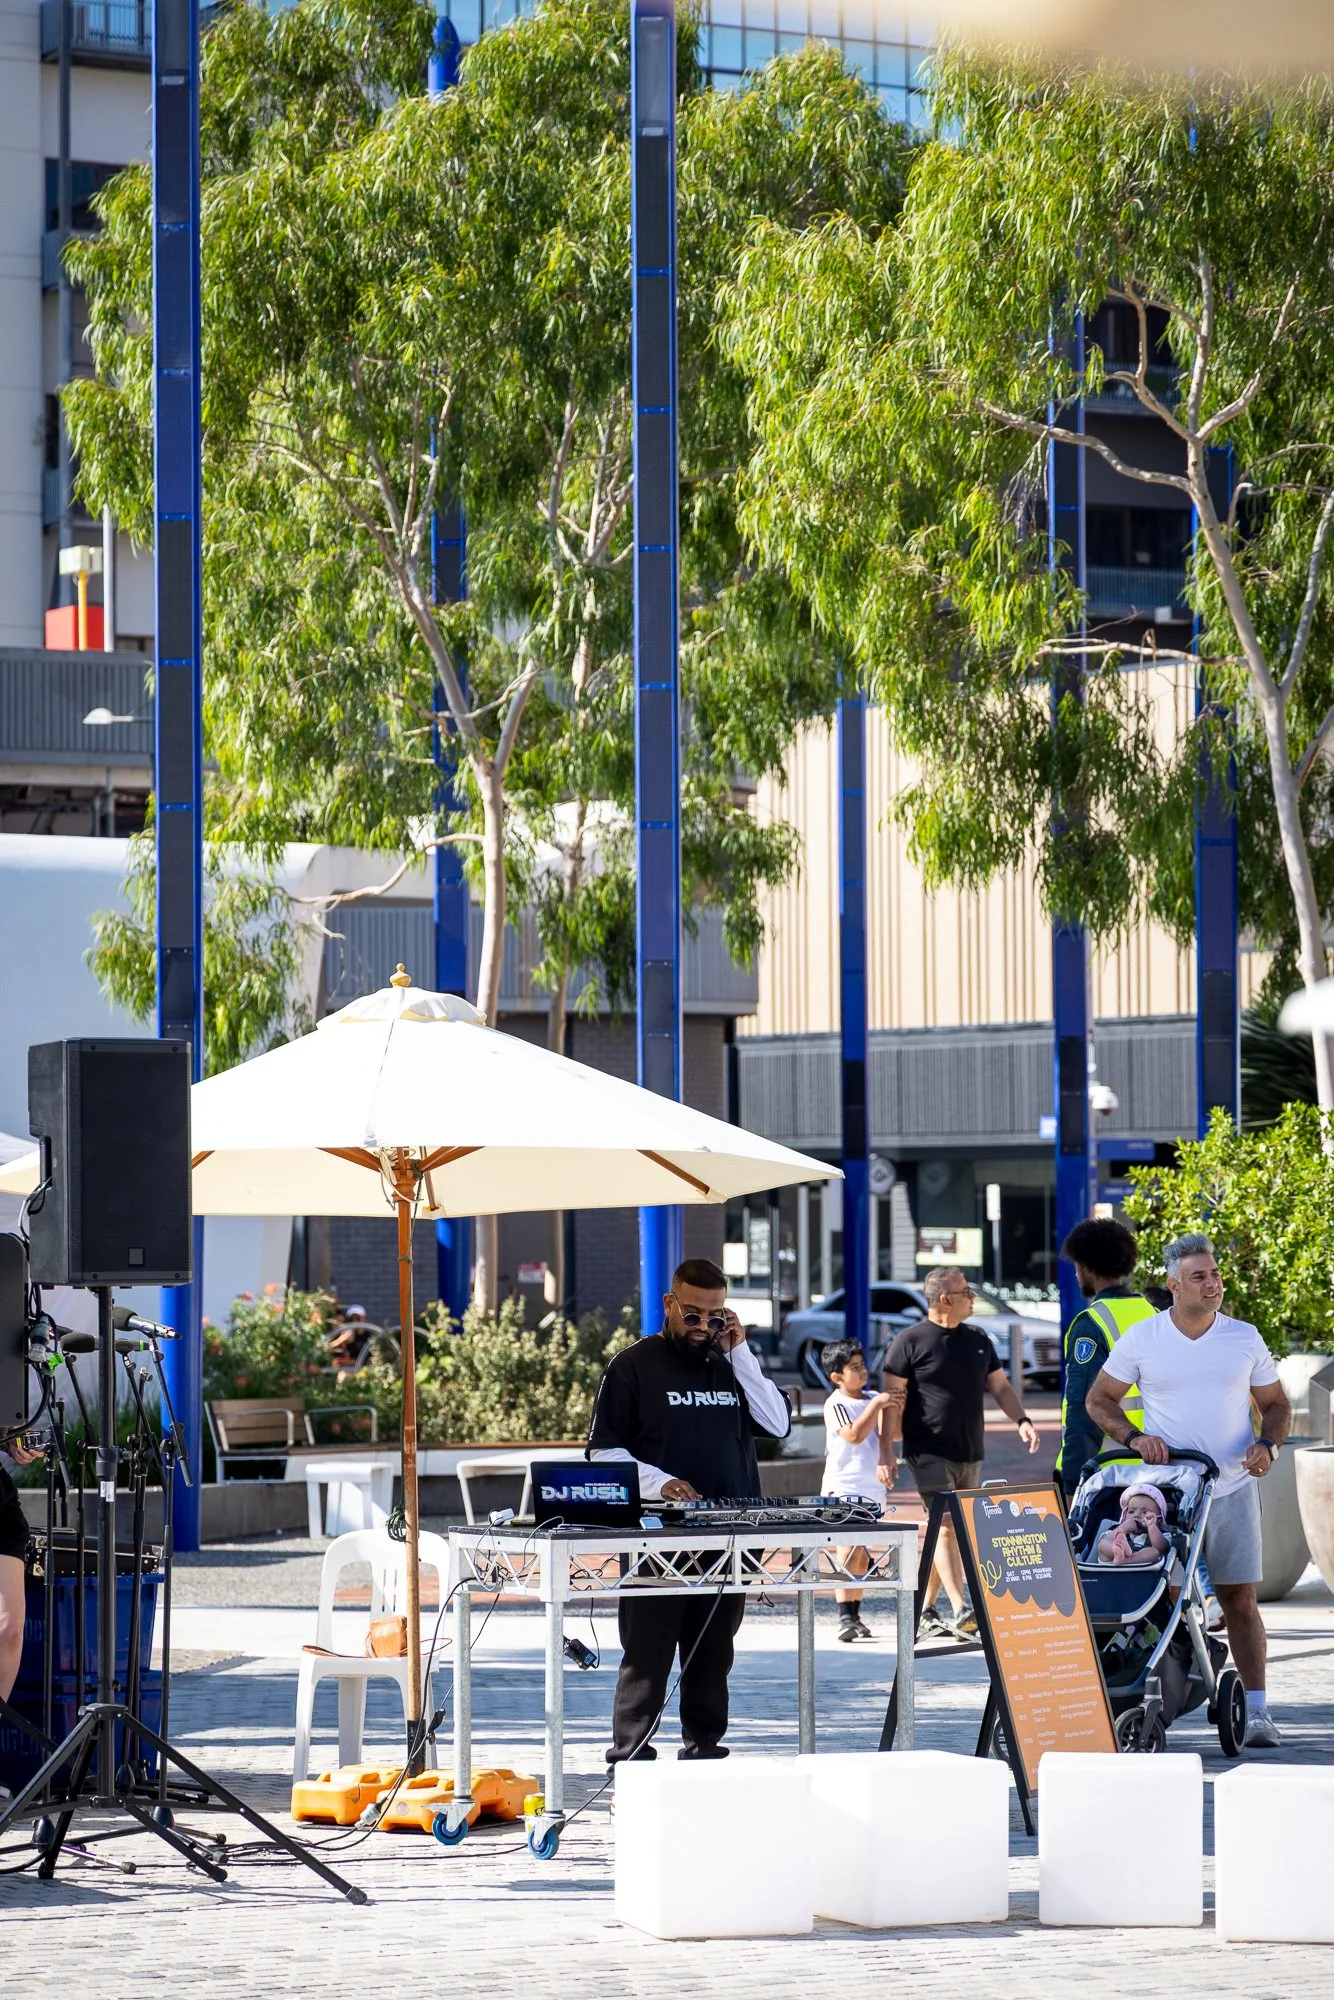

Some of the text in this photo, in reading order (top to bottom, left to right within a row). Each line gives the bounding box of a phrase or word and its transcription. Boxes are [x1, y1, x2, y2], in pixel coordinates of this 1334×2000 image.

[666, 1391, 740, 1406] DJ RUSH
[541, 1486, 626, 1500] DJ RUSH
[992, 1533, 1047, 1548] STONNINGTON
[1002, 1544, 1042, 1557] RHYTHM &
[1007, 1554, 1043, 1567] CULTURE
